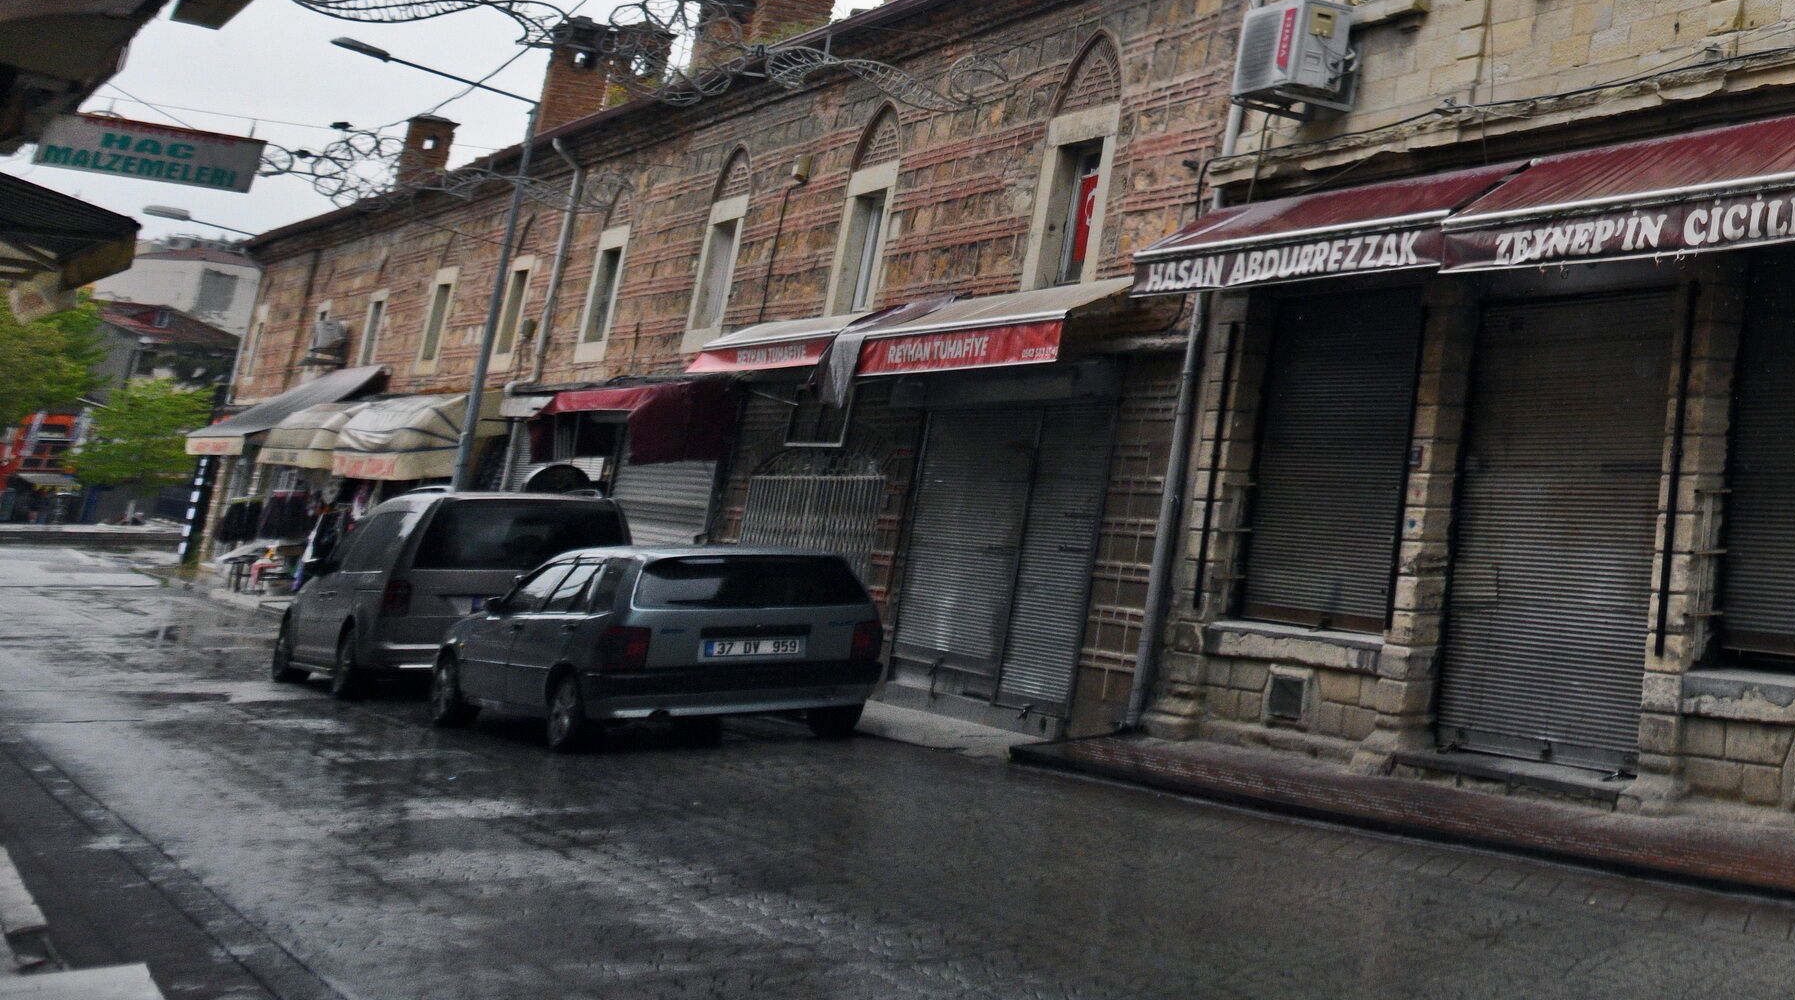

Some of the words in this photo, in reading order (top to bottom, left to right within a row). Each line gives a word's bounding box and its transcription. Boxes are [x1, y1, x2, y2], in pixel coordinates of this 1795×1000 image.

[101, 132, 197, 160] HAC
[1146, 254, 1226, 293] HASAN
[887, 342, 932, 364] REYHAN
[933, 334, 990, 359] TUHAFİYE
[717, 642, 735, 655] 37
[743, 641, 760, 655] DV
[772, 639, 798, 654] 959
